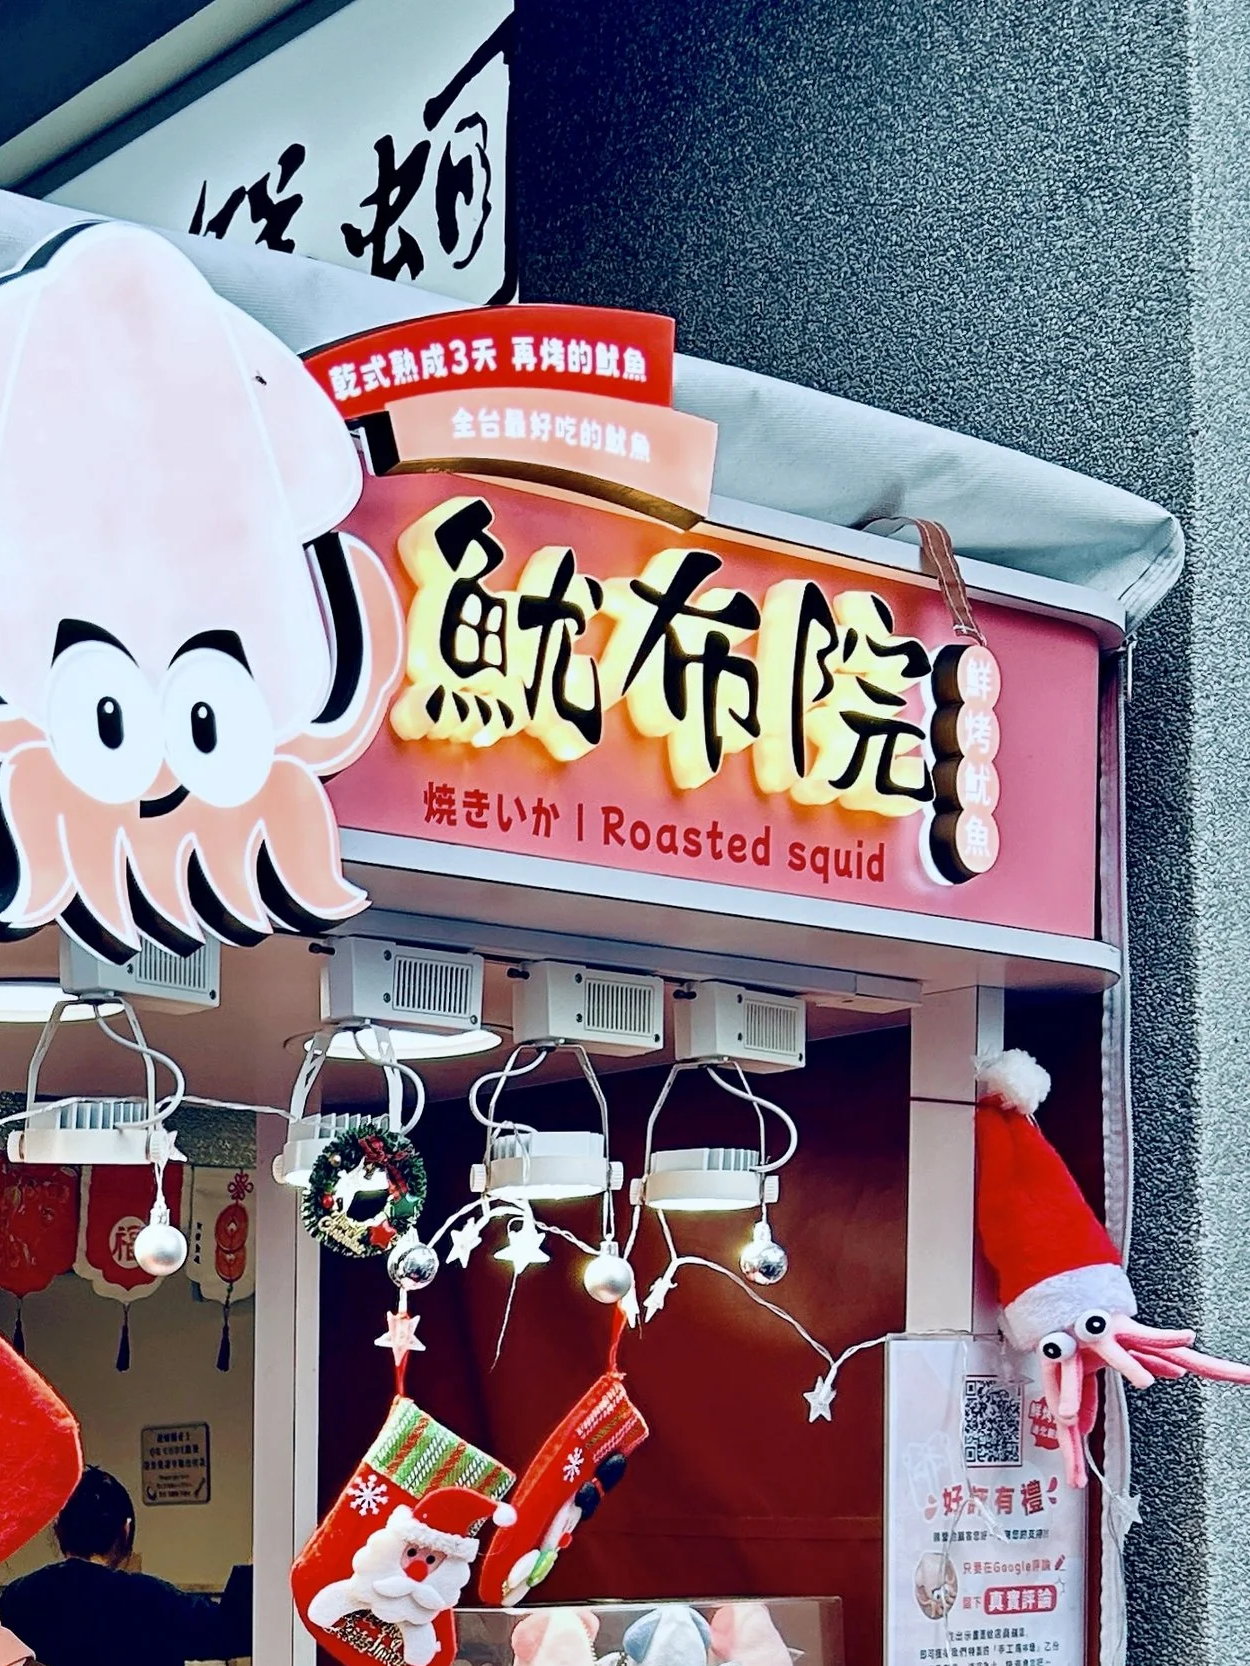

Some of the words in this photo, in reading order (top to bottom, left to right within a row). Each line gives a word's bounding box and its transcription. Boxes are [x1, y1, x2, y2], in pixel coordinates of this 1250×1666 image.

[328, 338, 498, 402] 乾式熟成3天
[510, 336, 648, 384] 再烤的魷魚
[451, 406, 651, 464] 全台最好吃的魷魚
[426, 498, 936, 803] 魷布院
[962, 657, 993, 860] 鮮烤魷魚
[422, 781, 561, 840] 焼きいか
[602, 805, 772, 867] Roasted
[786, 841, 886, 884] squid
